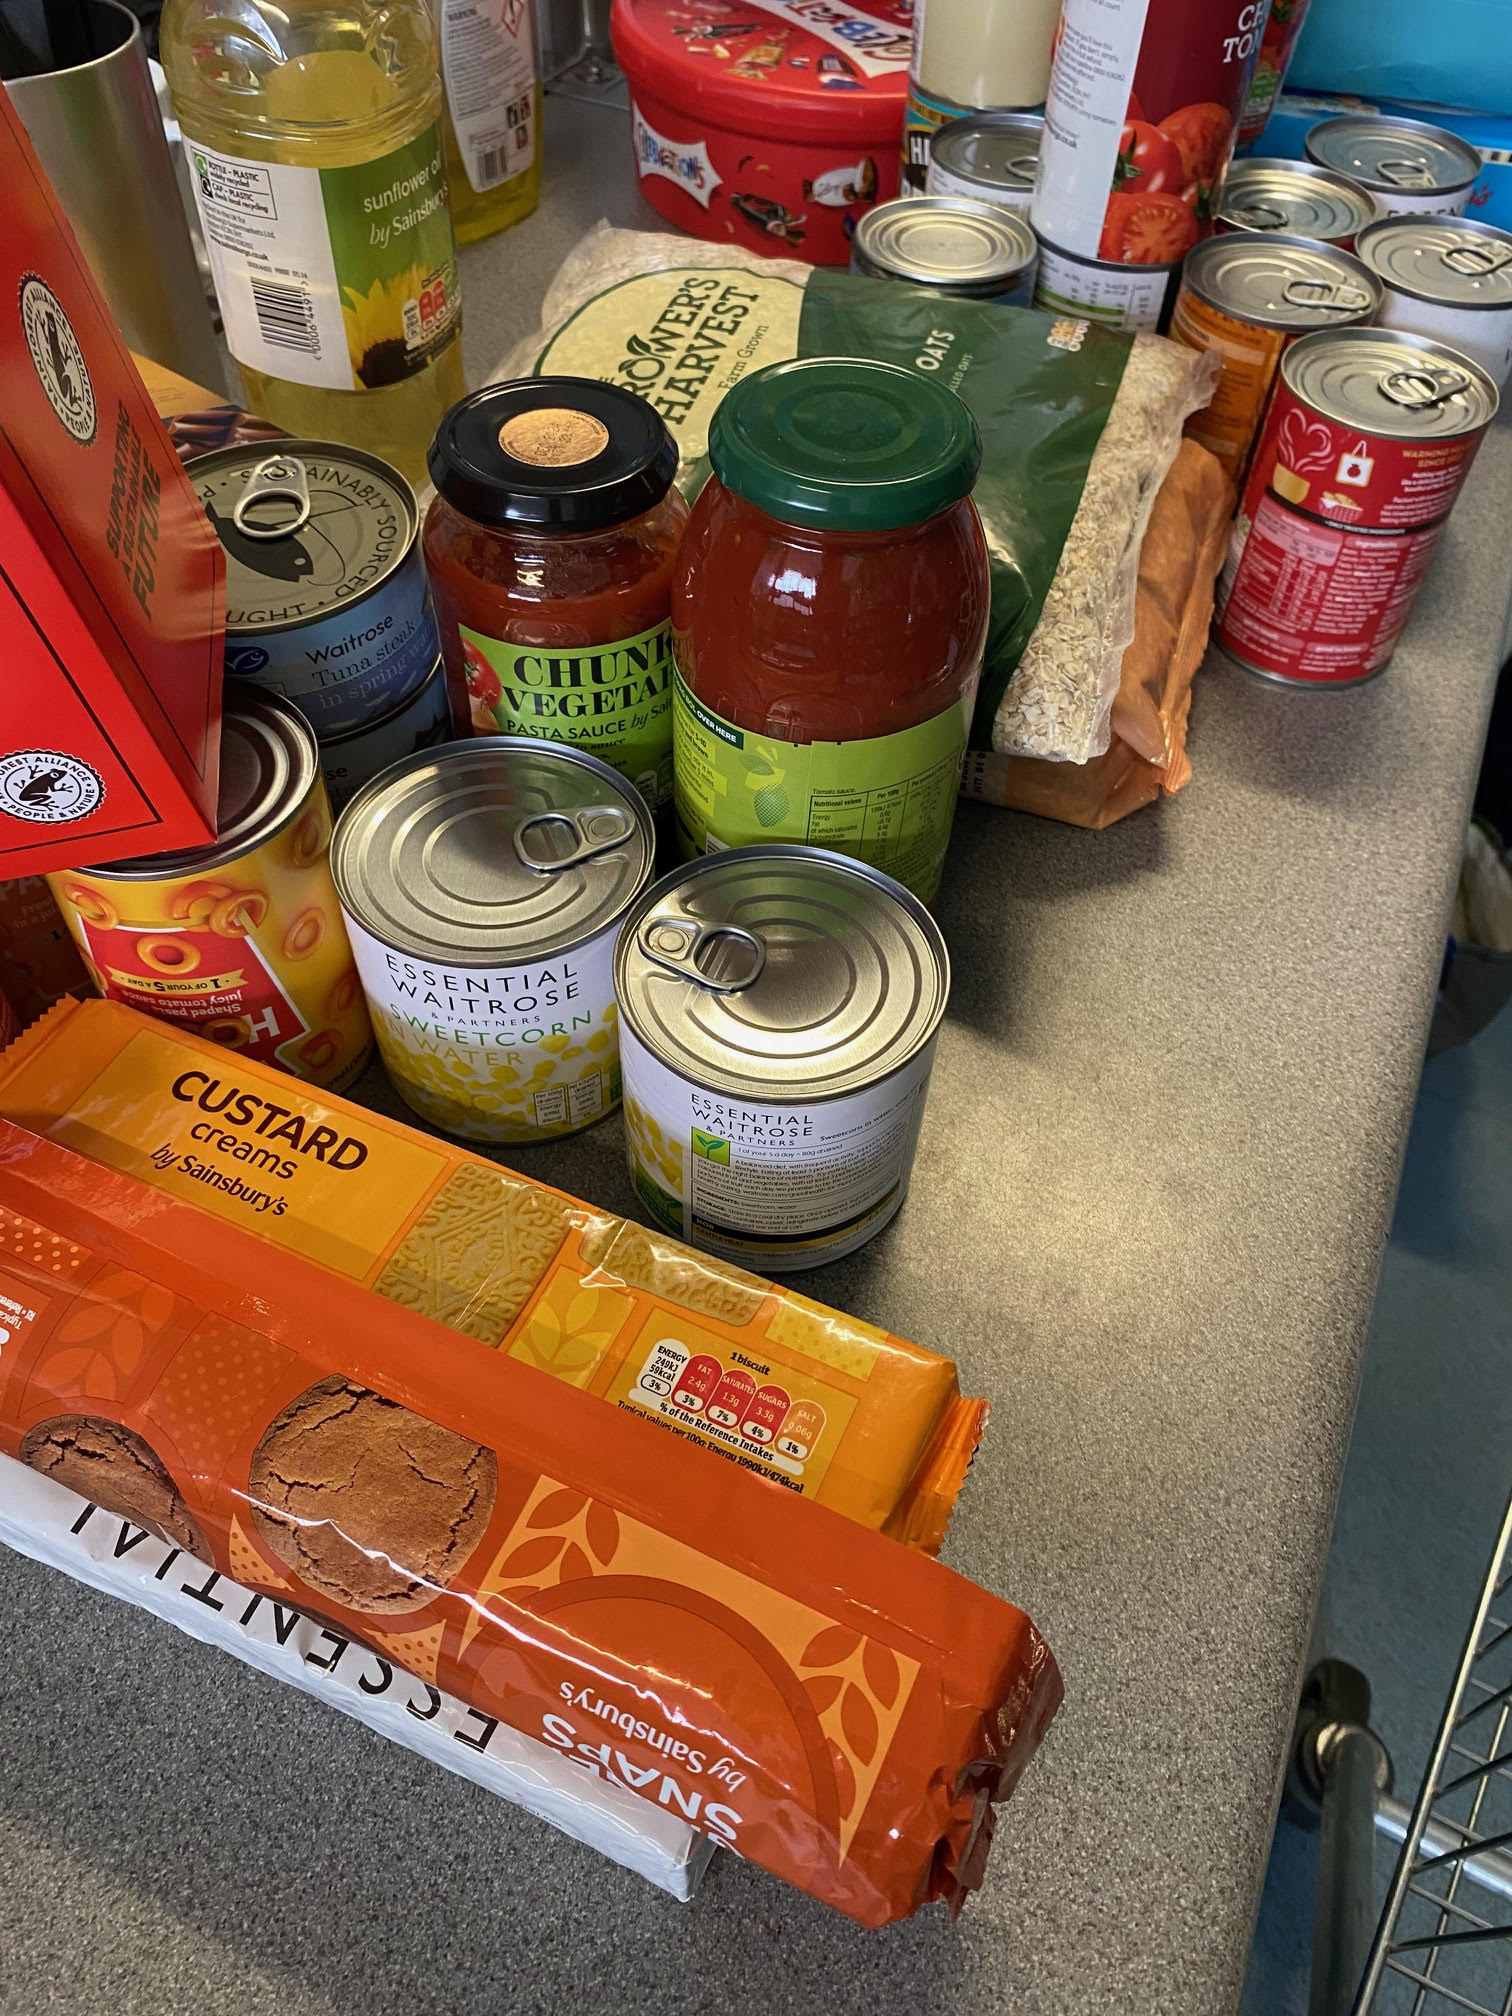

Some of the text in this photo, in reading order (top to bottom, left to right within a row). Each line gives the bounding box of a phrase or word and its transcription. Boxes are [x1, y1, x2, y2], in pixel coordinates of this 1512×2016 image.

[233, 169, 259, 182] PLASTIC
[229, 188, 254, 202] PLASTIC
[363, 166, 430, 213] sunflower
[241, 201, 269, 214] recycling
[369, 223, 391, 249] by
[617, 277, 721, 401] ROWER'S
[915, 329, 956, 371] OATS
[653, 285, 760, 426] HARVEST
[717, 325, 769, 390] Farm Grown
[132, 447, 161, 623] FUTURE
[333, 513, 398, 598] SOURCED
[225, 602, 307, 624] UGHT
[304, 615, 394, 666] Waitrose
[311, 655, 372, 688] Tuna
[375, 619, 416, 663] steak
[512, 628, 674, 689] CHUNK
[318, 658, 408, 709] in spring
[506, 713, 649, 740] PASTA SAUCE by
[696, 710, 738, 743] OVER HERE
[34, 756, 91, 783] ALLIANCE
[7, 803, 55, 820] PEOPLE
[68, 788, 95, 815] NATURE
[813, 799, 844, 807] Nutritional
[812, 813, 831, 821] Energy
[385, 952, 578, 994] ESSENTIAL
[153, 981, 166, 992] 5
[390, 973, 580, 1015] WAITROSE
[158, 998, 208, 1009] tomato
[190, 1003, 241, 1018] Shaped
[389, 1002, 593, 1047] SWEETCORN
[430, 1011, 542, 1027] & PARTNERS
[413, 1032, 525, 1067] WATER
[690, 1093, 814, 1126] ESSENTIAL
[171, 1070, 369, 1172] CUSTARD
[691, 1105, 814, 1138] WAITROSE
[705, 1124, 796, 1147] & PARTNERS
[820, 1124, 863, 1142] Sweetcorn
[190, 1122, 299, 1180] creams
[750, 1149, 767, 1158] your
[781, 1150, 795, 1159] day
[816, 1143, 843, 1156] drained
[740, 1160, 773, 1170] balanced
[788, 1162, 804, 1170] with
[749, 1171, 777, 1180] balance
[149, 1141, 289, 1217] by Sainsbury's
[655, 1356, 679, 1373] 249kJ
[657, 1344, 689, 1364] ENERGY
[730, 1351, 771, 1376] 1 biscuit
[649, 1364, 676, 1382] 59kcal
[697, 1364, 713, 1375] FAT
[648, 1379, 661, 1391] 3%
[687, 1376, 707, 1393] 2.4g
[721, 1375, 755, 1395] SATURATES
[682, 1394, 695, 1407] 3%
[722, 1391, 740, 1408] 1.3g
[757, 1391, 788, 1410] SUGARS
[716, 1409, 729, 1422] 7%
[755, 1406, 775, 1423] 3.3g
[797, 1409, 817, 1423] SALT
[660, 1401, 775, 1462] % of the Reference Intakes
[751, 1425, 764, 1439] 4%
[788, 1421, 813, 1440] 0.06g
[785, 1441, 799, 1455] 1%
[558, 1680, 748, 1793] by Sainsbury's
[540, 1713, 745, 1841] SNAPS
